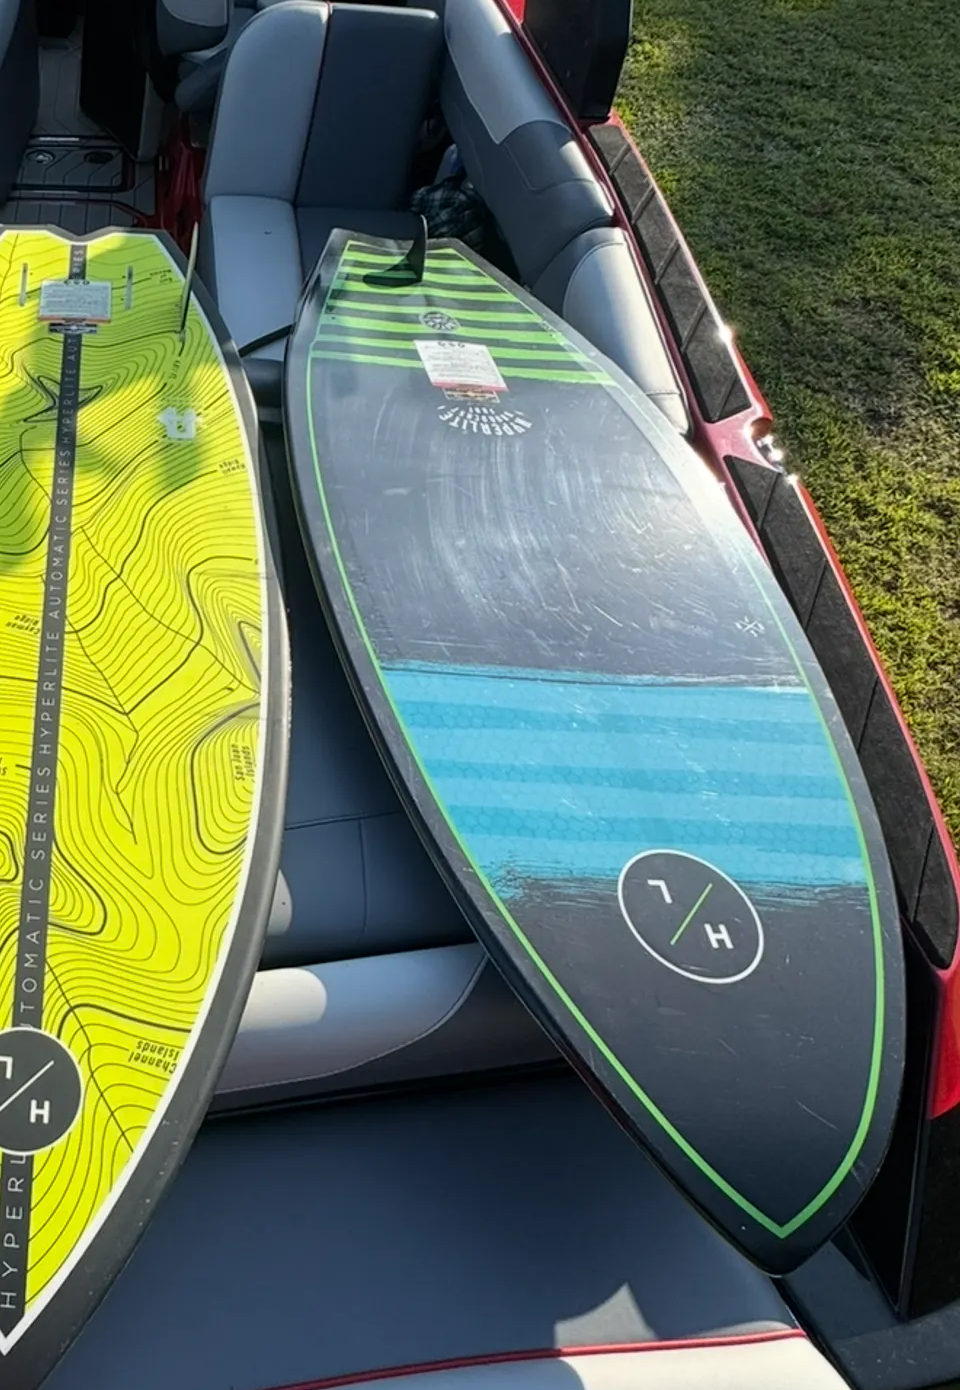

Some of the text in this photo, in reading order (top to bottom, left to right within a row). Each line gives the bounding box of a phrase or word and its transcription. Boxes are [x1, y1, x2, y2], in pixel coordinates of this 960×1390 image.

[62, 369, 76, 444] HYPERLITE
[438, 410, 534, 436] HYPERLITE
[56, 450, 73, 506] SERIES
[48, 515, 68, 619] AUTOMATIC
[39, 631, 60, 755] HYPERLITE
[234, 765, 246, 781] San
[31, 766, 51, 860] SERIES
[127, 1051, 178, 1075] Channel
[136, 1040, 180, 1062] Islands
